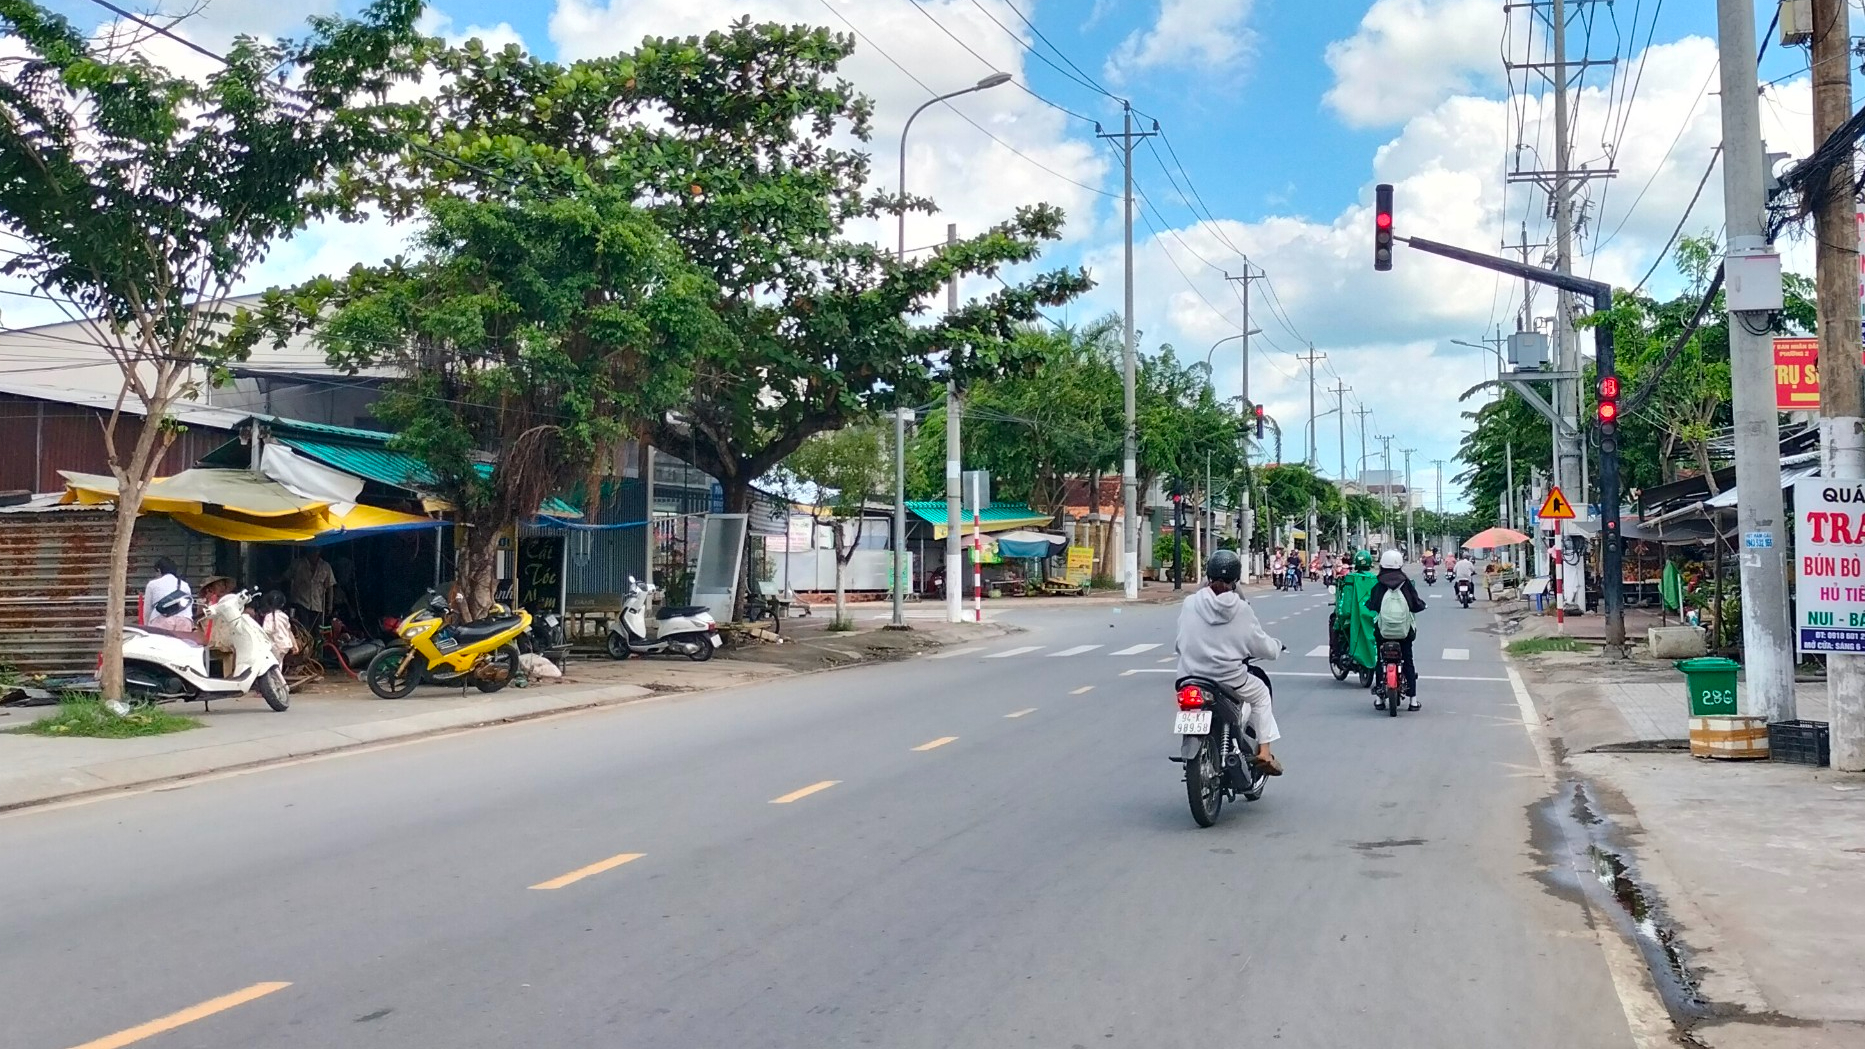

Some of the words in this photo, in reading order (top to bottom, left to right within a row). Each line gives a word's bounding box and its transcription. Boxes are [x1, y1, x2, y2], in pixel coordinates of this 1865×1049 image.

[1822, 484, 1865, 503] QUÁ
[1804, 553, 1836, 576] BÚN
[1841, 553, 1861, 578] BÒ
[1820, 582, 1840, 601] HỦ
[1808, 611, 1834, 626] NUI
[1827, 632, 1845, 640] 0918
